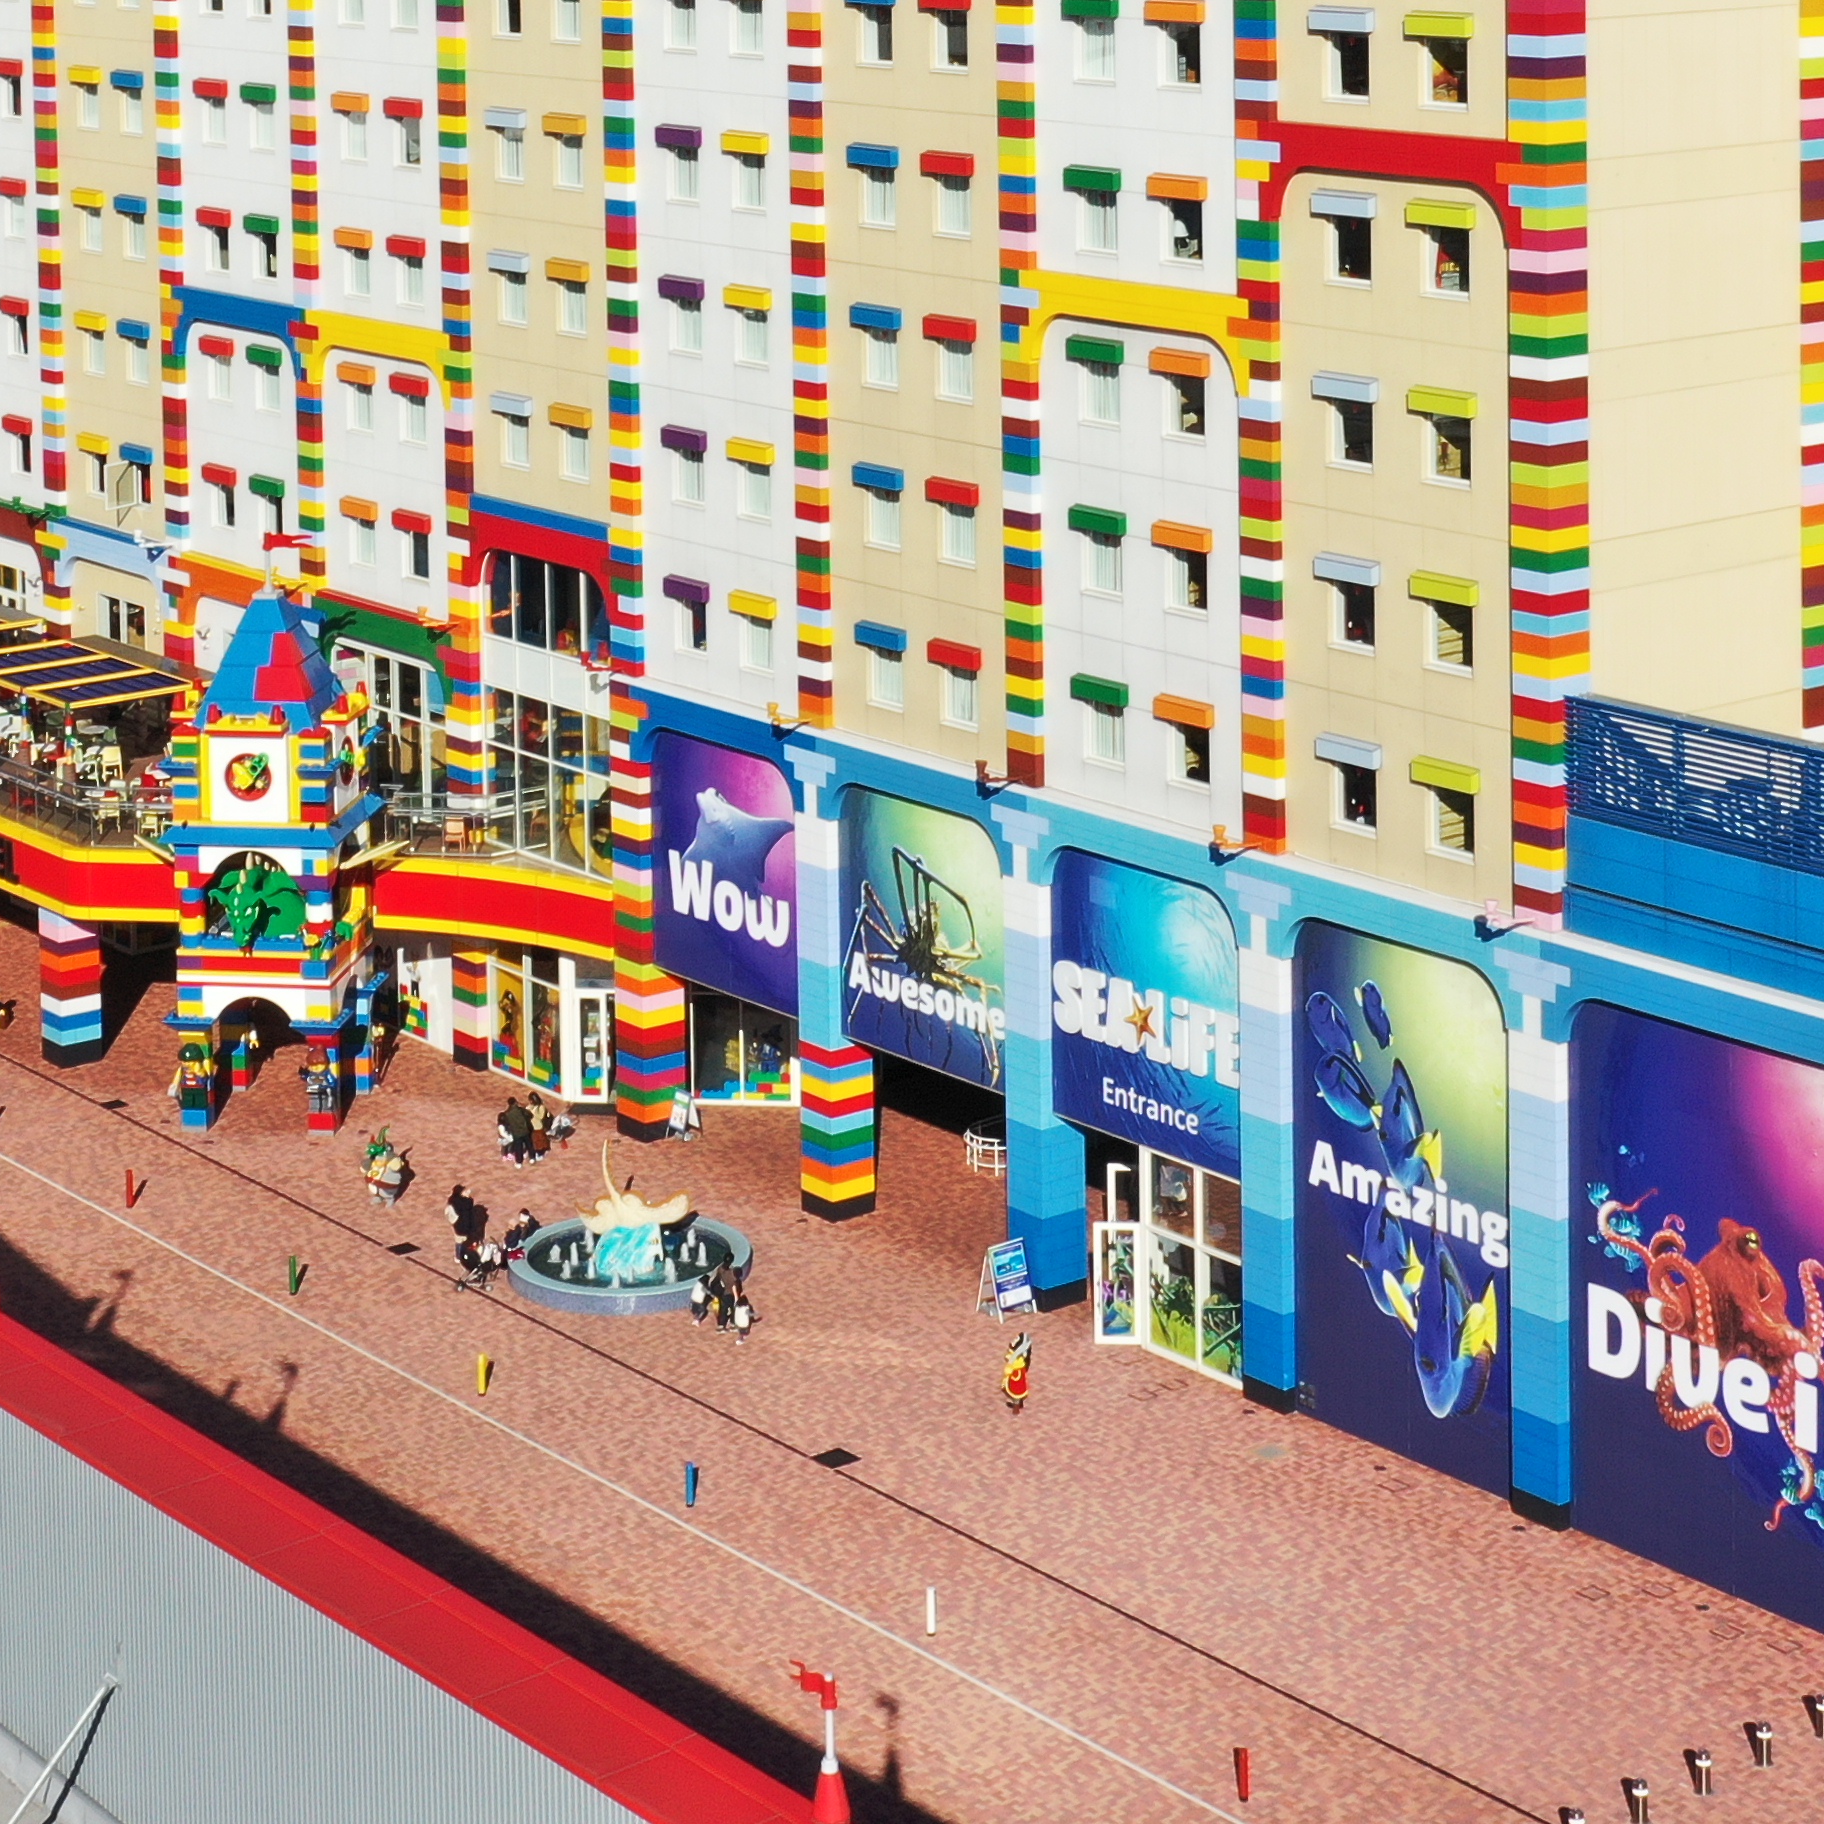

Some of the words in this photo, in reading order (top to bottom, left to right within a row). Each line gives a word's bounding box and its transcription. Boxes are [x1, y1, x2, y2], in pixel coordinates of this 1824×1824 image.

[668, 848, 790, 948] Wow
[848, 950, 1005, 1041] Awesome
[1053, 960, 1144, 1054] SEA
[1102, 1076, 1200, 1135] Entrance
[1308, 1139, 1509, 1269] Amazing
[1587, 1281, 1771, 1434] Dive
